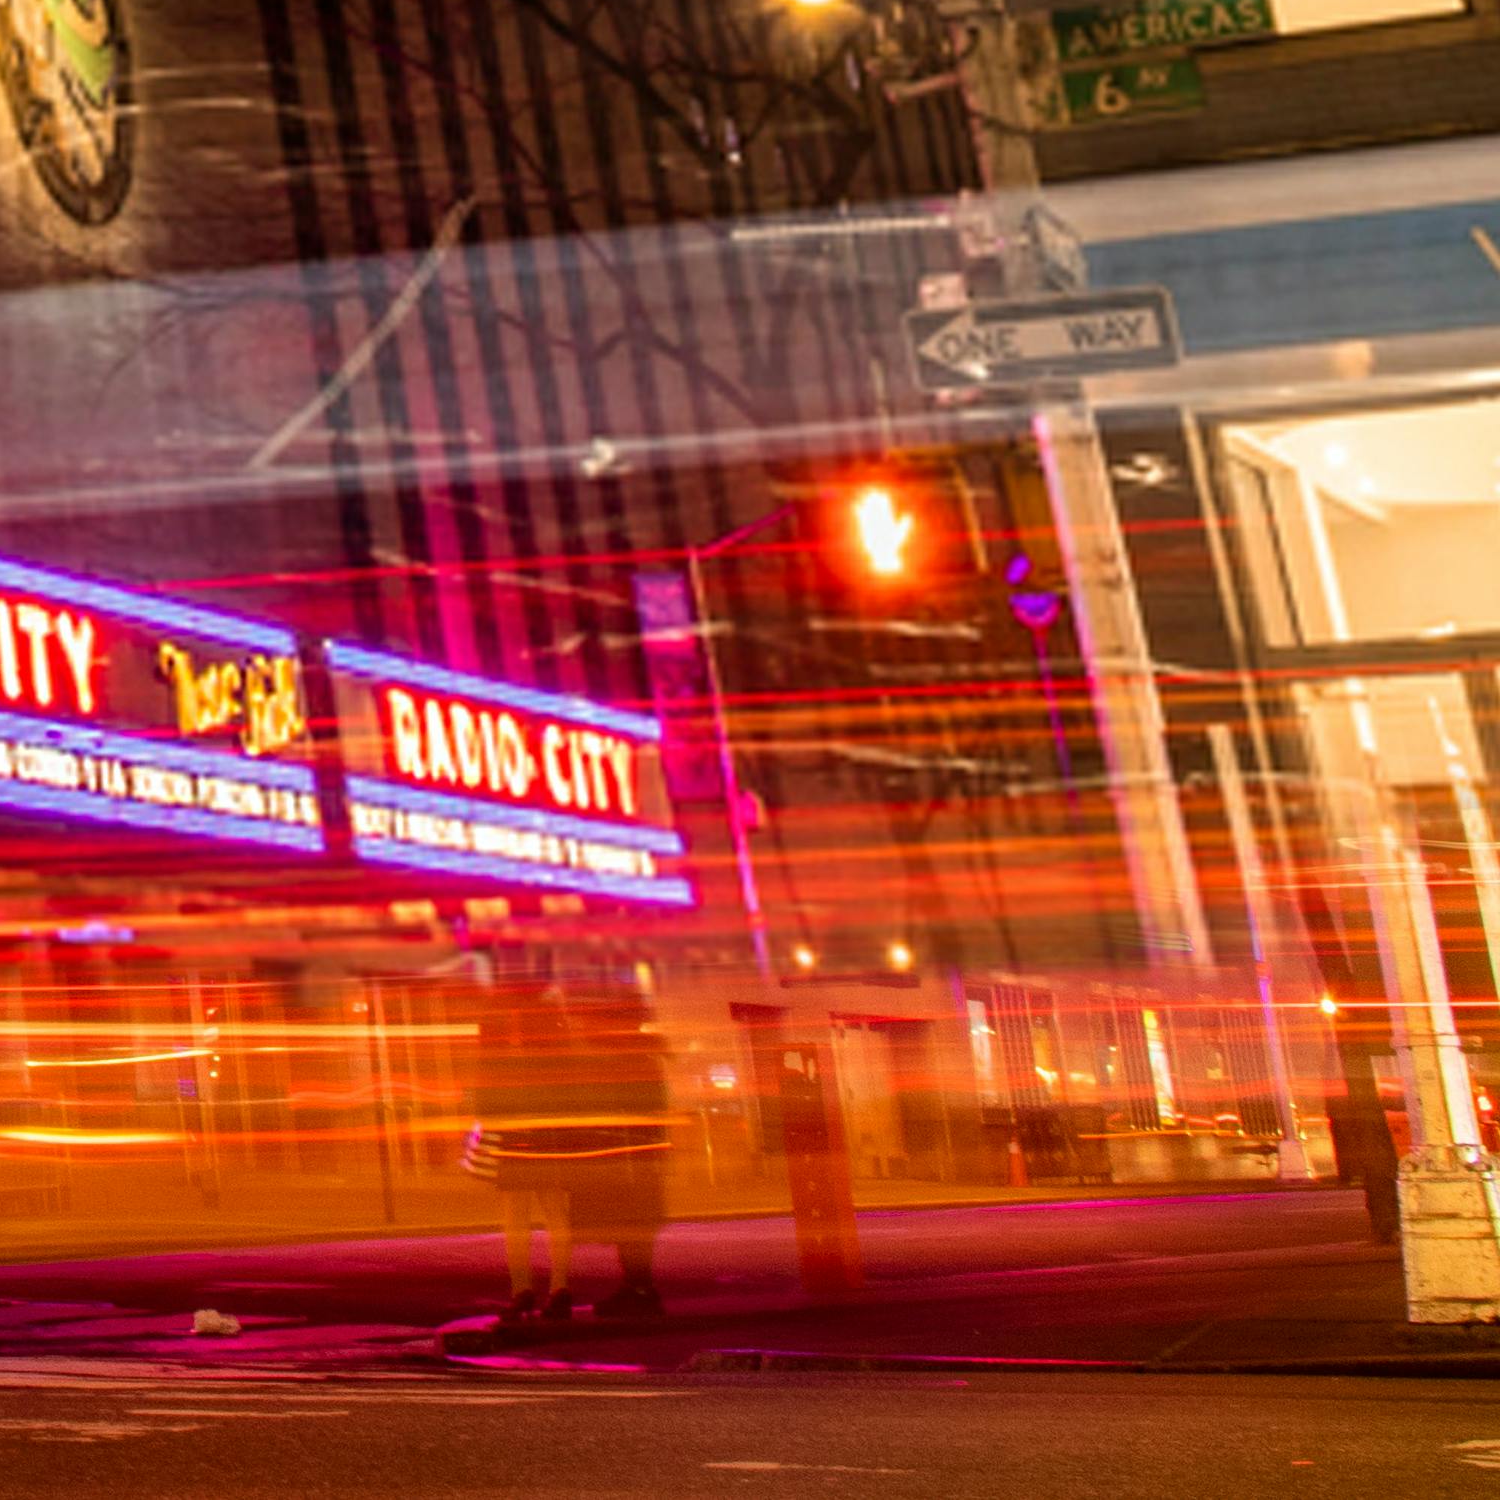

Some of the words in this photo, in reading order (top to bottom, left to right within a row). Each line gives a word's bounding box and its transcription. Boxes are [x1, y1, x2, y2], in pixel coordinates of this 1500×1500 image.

[1094, 72, 1132, 115] 6
[936, 326, 1022, 364] ONE
[1063, 313, 1145, 351] WAY
[386, 687, 530, 798] RADIO
[542, 724, 636, 816] CITY
